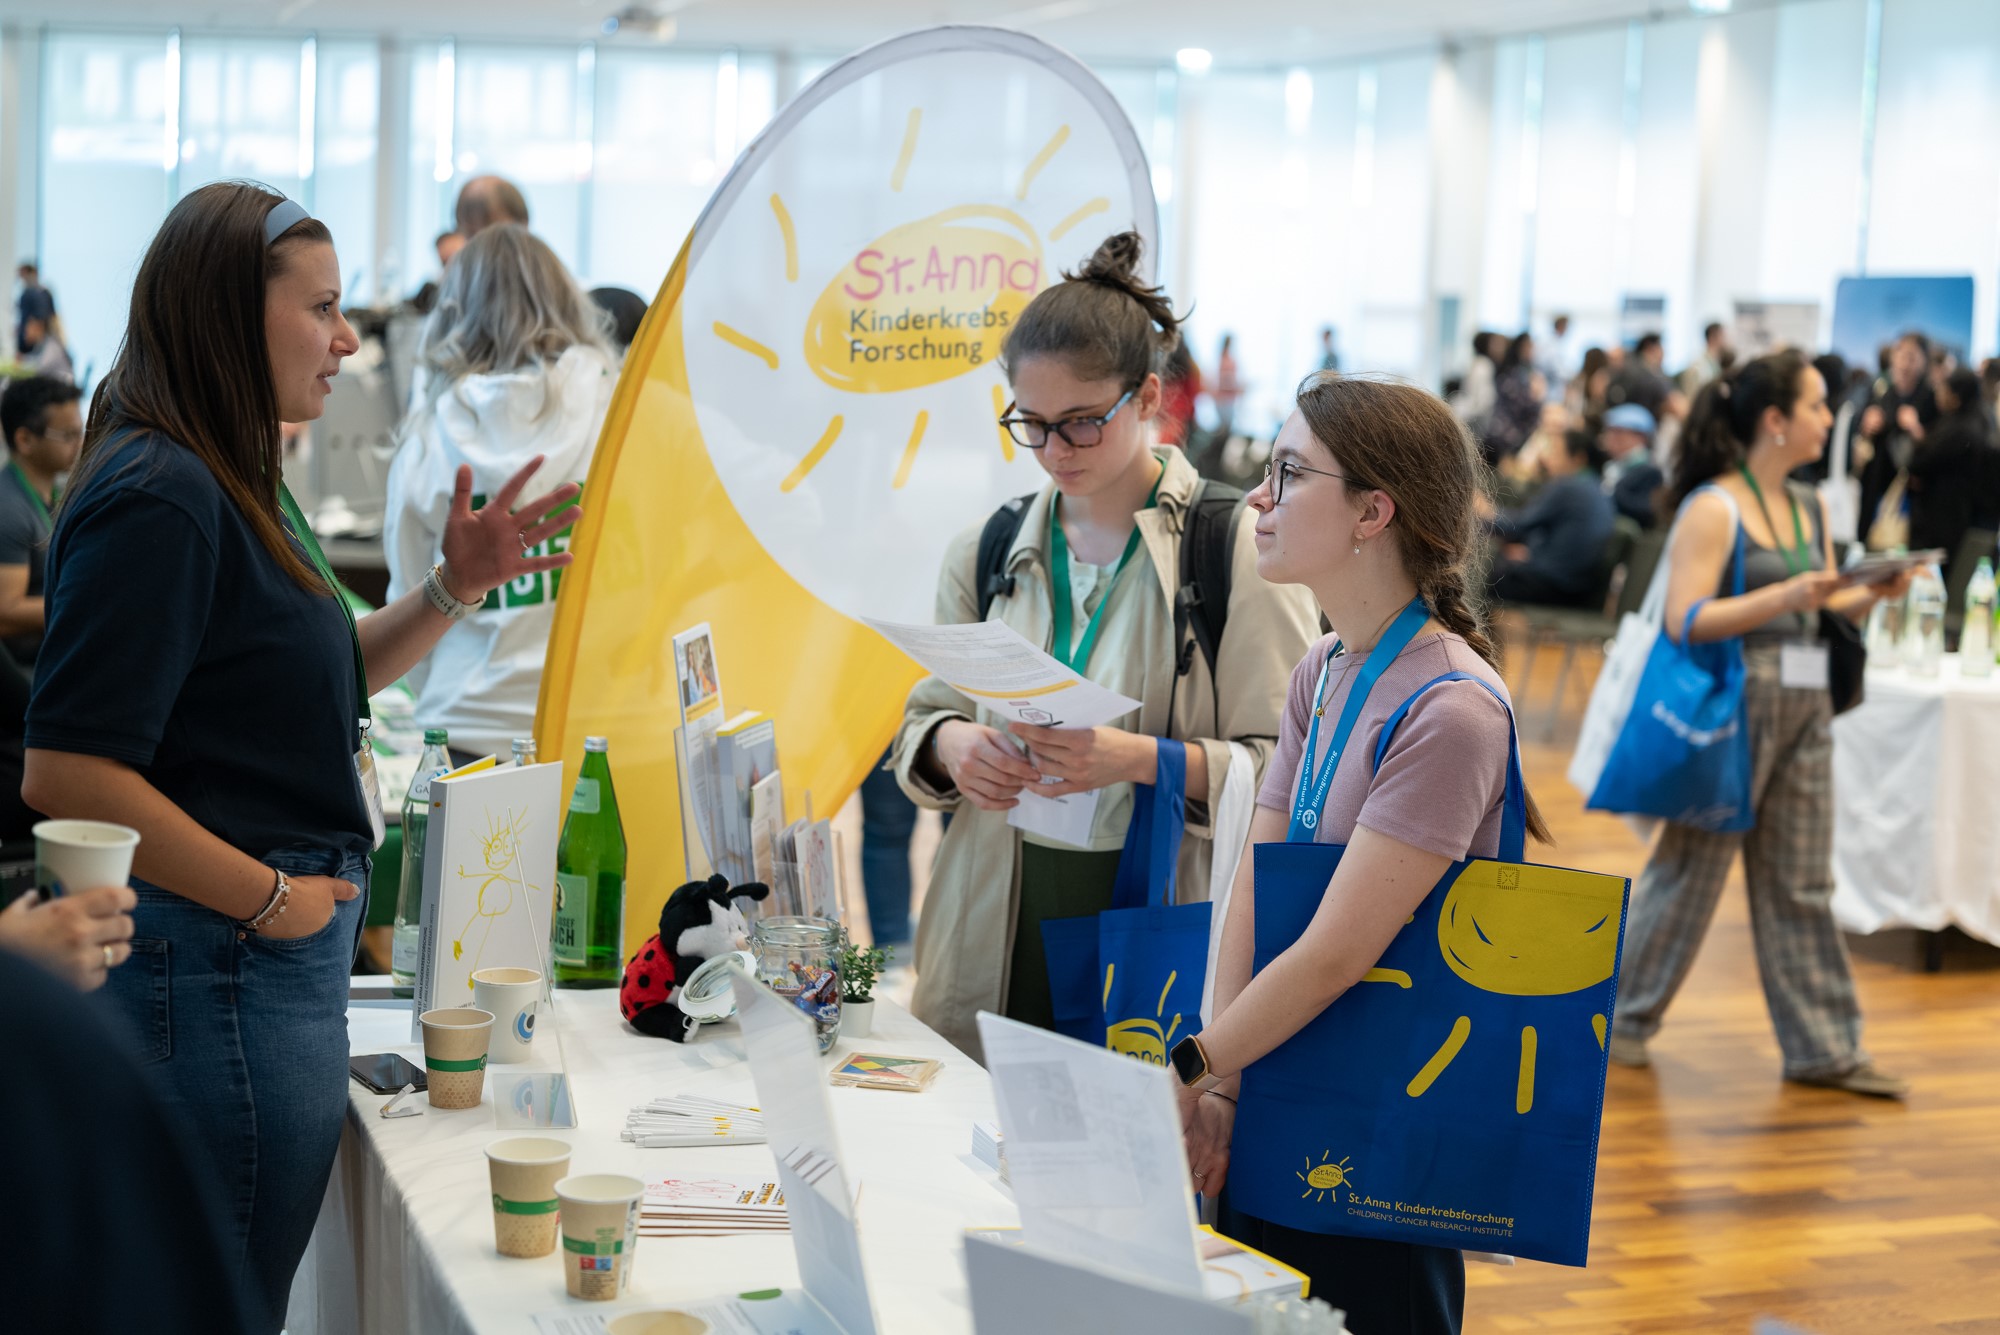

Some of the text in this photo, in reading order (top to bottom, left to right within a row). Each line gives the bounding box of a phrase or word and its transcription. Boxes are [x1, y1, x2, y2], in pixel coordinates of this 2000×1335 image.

[850, 305, 1009, 333] Kinderkrebs
[850, 337, 983, 365] Forschung
[1298, 776, 1308, 808] Campus
[1304, 753, 1312, 775] Wien
[1311, 750, 1338, 808] Bioengineering
[1347, 1207, 1513, 1238] CHILDREN'S CANCER RESEARCH INSTITUTE
[1394, 1201, 1515, 1228] Kinderkrebsforschung
